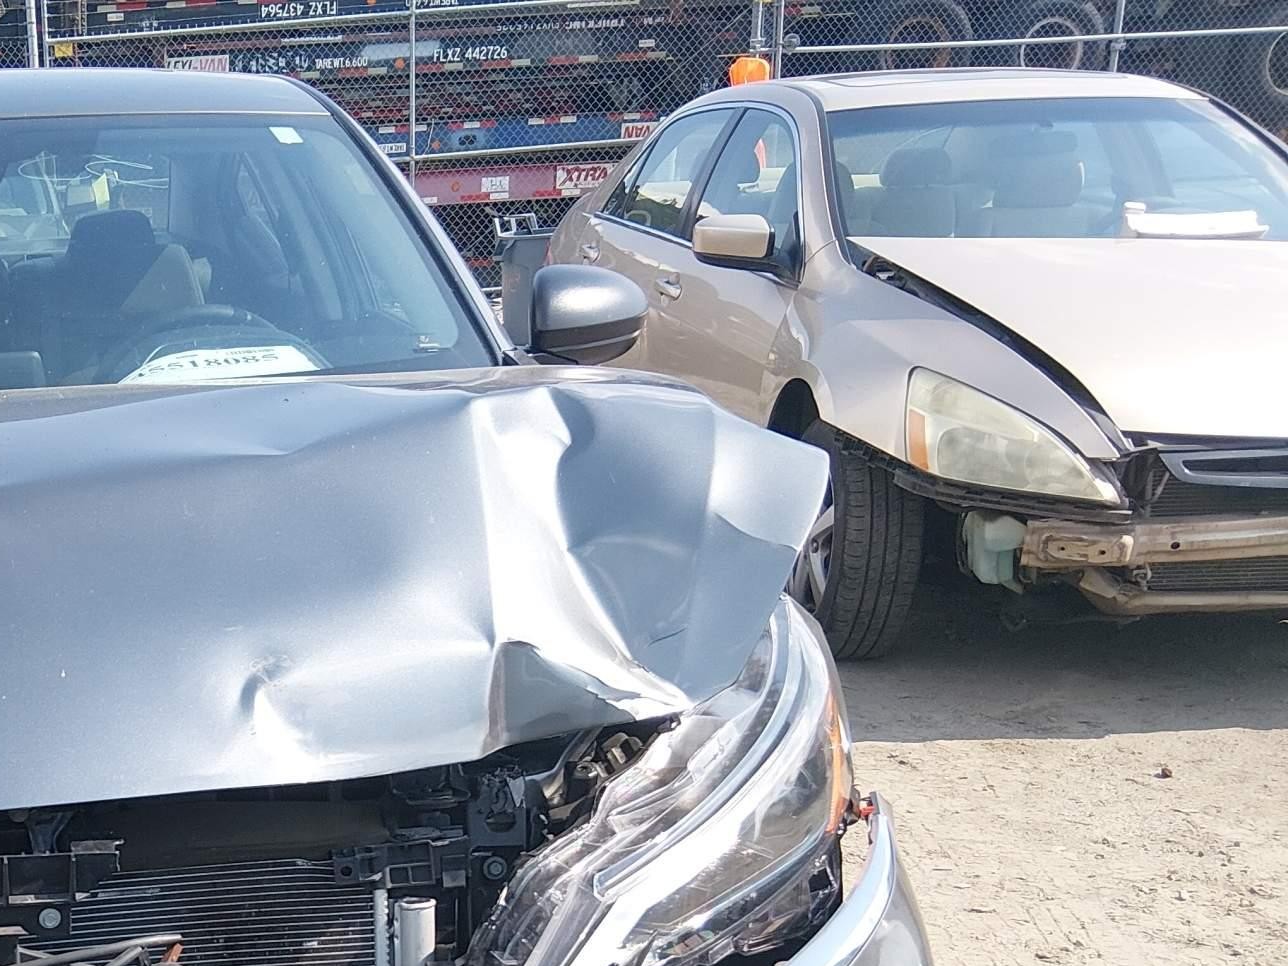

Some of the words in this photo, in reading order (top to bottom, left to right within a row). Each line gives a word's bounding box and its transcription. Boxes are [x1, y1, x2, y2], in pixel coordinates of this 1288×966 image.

[261, 1, 305, 17] 437564
[308, 4, 337, 18] FLXZ
[433, 47, 461, 62] FLXZ
[465, 45, 508, 60] 442726
